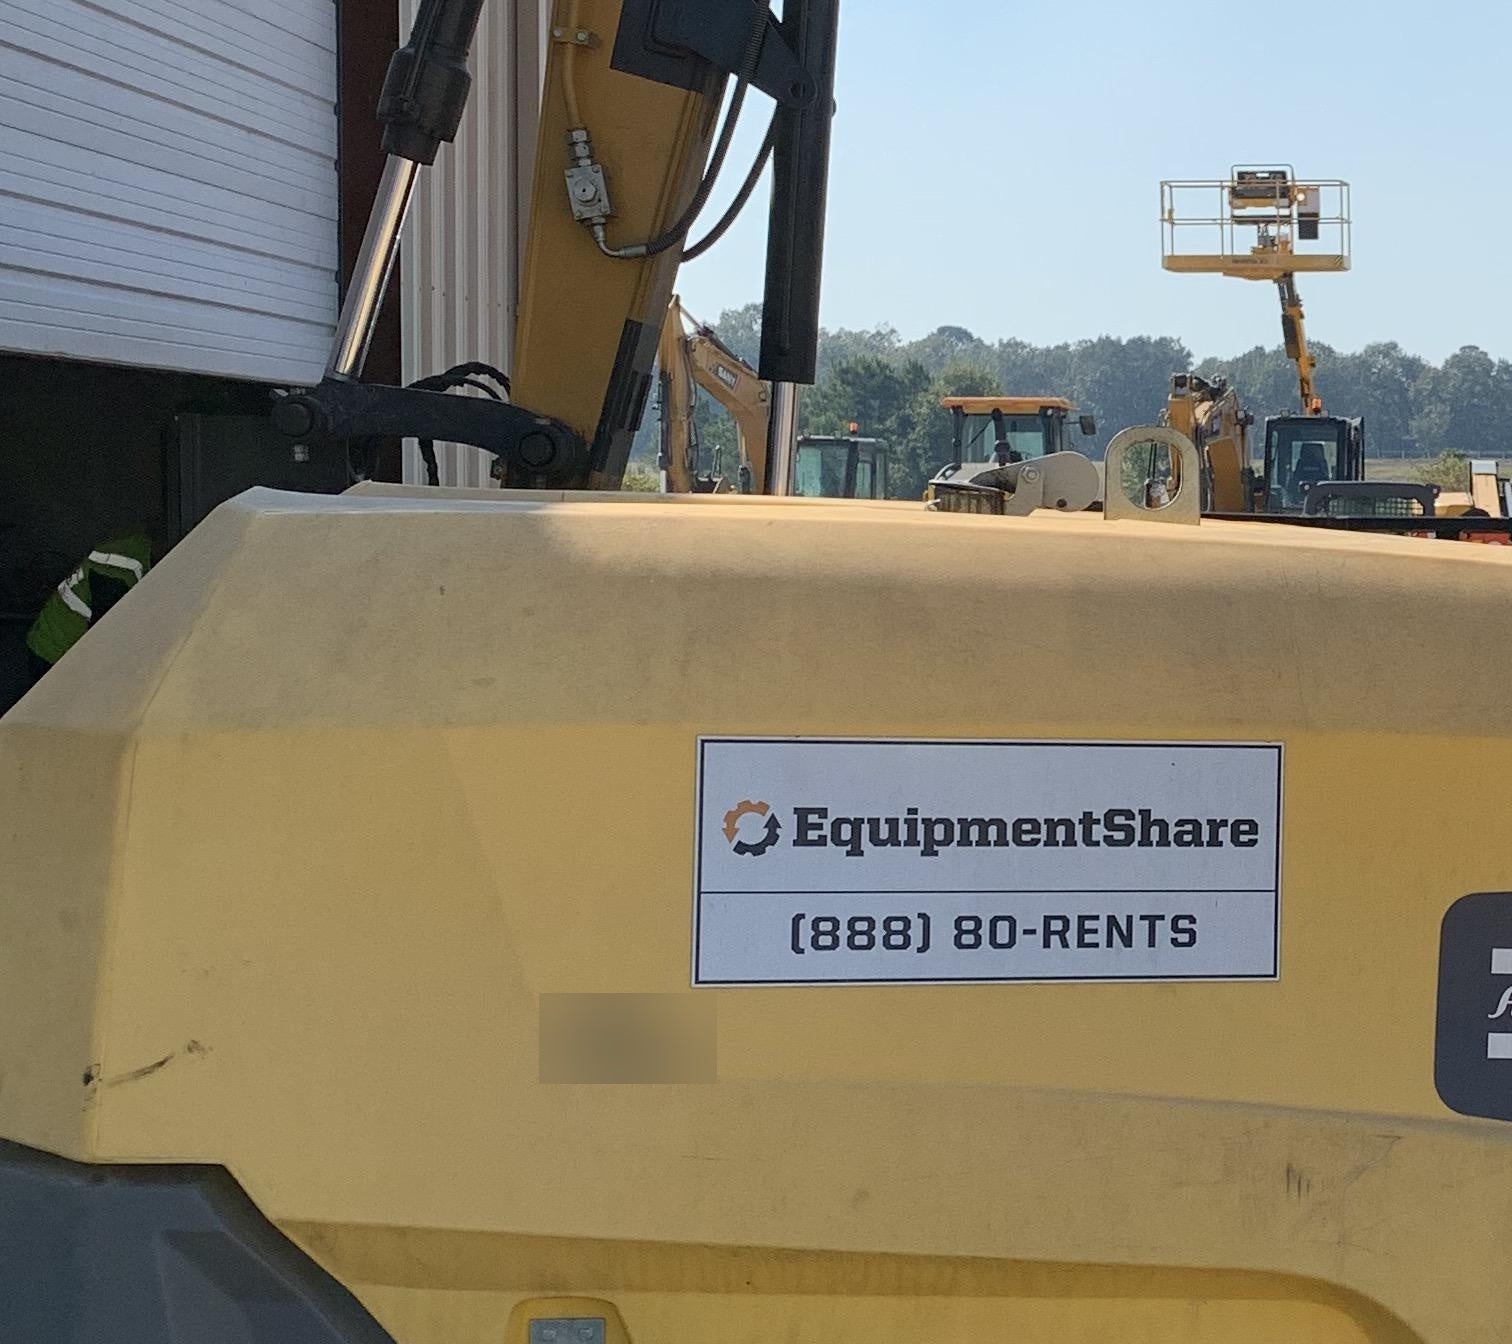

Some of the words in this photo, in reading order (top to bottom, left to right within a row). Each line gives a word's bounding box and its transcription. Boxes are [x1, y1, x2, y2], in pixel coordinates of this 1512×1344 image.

[792, 807, 1260, 857] EquipmentShare
[791, 912, 931, 954] (888)
[953, 913, 1199, 950] 80-RENTS
